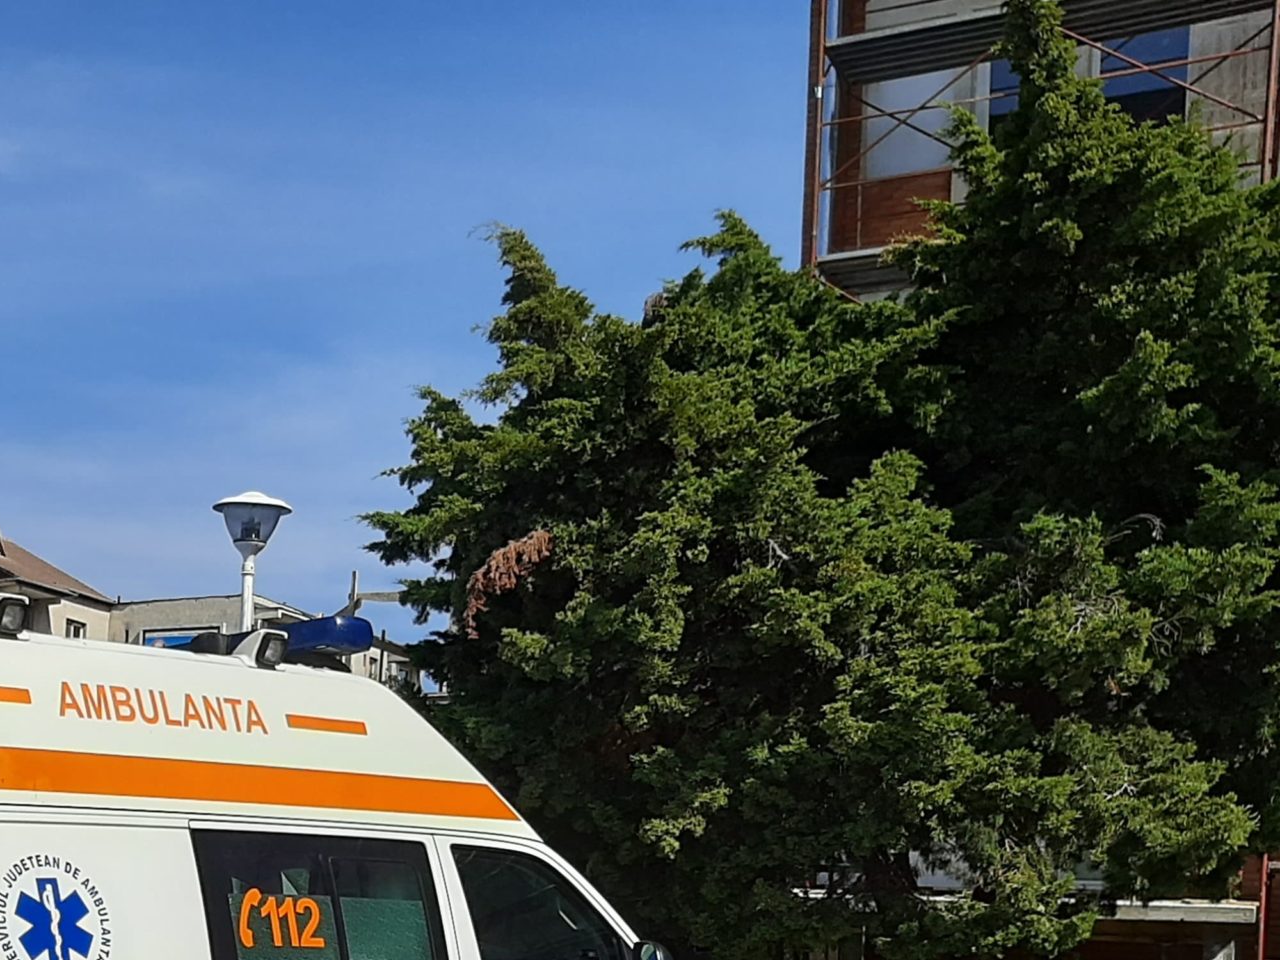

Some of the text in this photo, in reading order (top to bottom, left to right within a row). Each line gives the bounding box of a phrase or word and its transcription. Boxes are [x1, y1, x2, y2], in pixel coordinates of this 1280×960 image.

[58, 681, 269, 735] AMBULANTA
[2, 854, 61, 889] JUDETEAN
[63, 861, 81, 881] DE
[260, 895, 326, 948] 112
